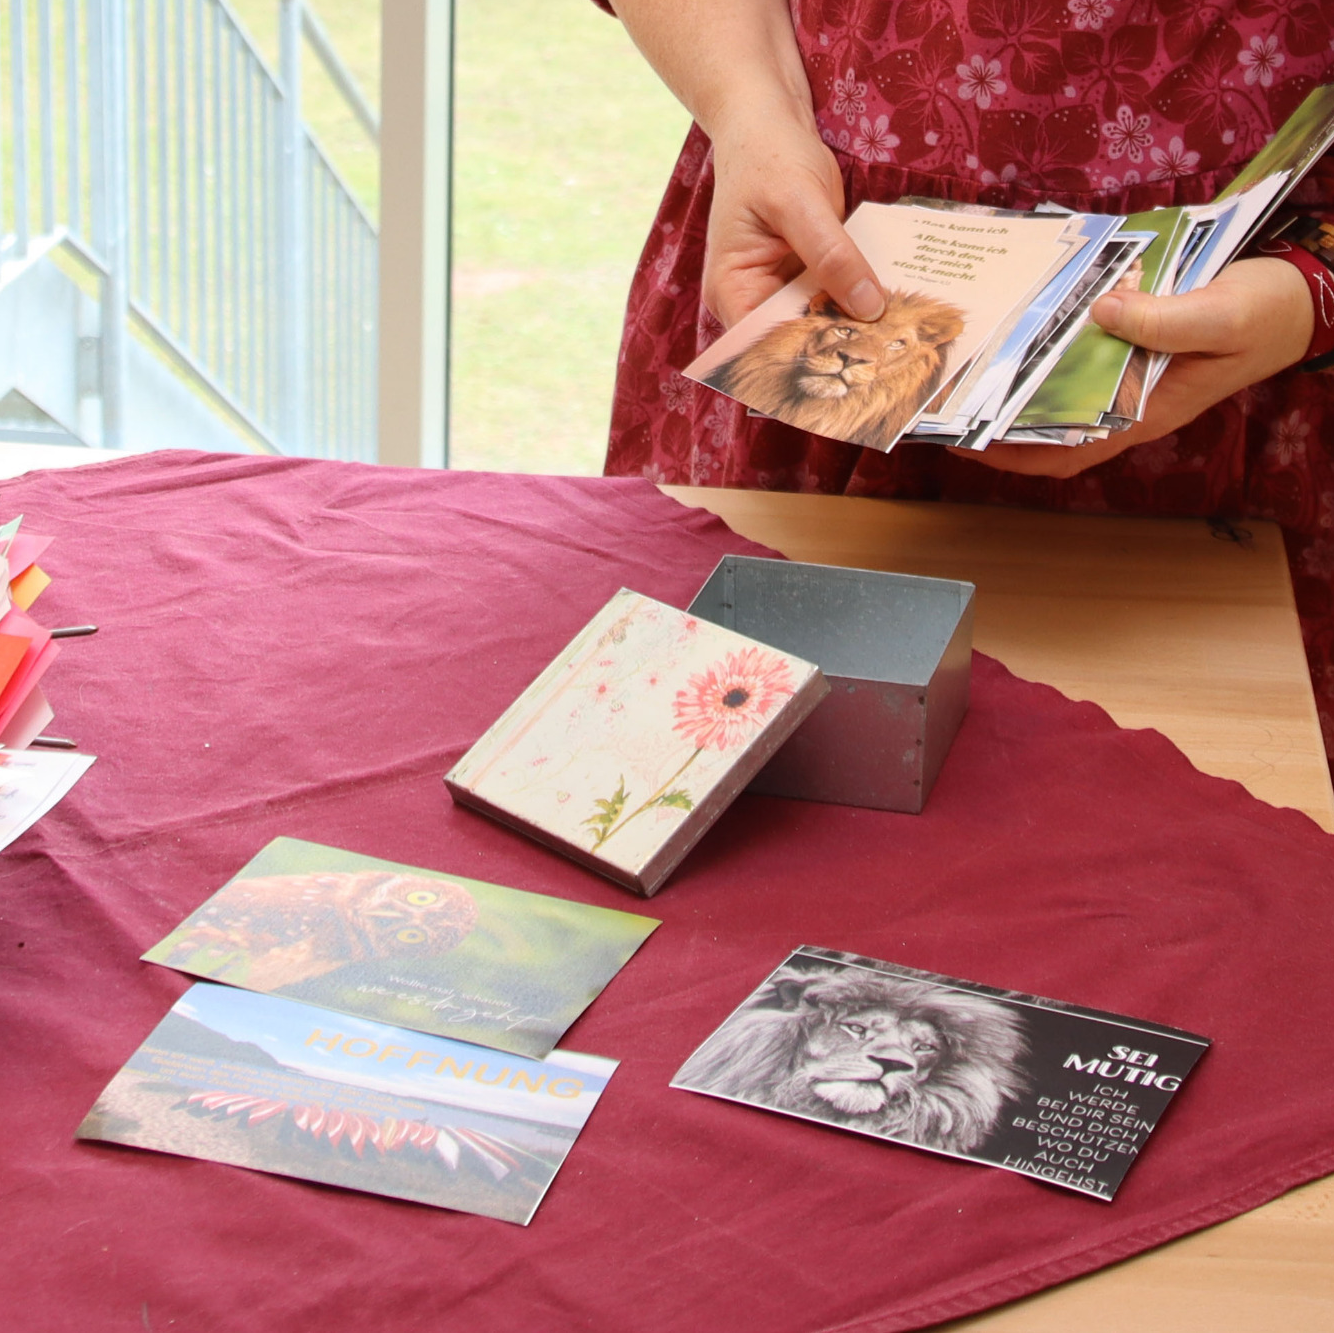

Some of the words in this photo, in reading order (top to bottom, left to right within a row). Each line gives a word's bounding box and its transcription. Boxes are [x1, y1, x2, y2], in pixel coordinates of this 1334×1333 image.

[987, 227, 1009, 235] ich
[913, 233, 948, 245] Alles
[950, 240, 985, 252] kann
[987, 246, 1008, 255] ich
[916, 244, 957, 257] durch
[892, 260, 931, 273] stark
[930, 268, 977, 282] macht.
[913, 254, 939, 263] der
[938, 260, 974, 270] mich
[389, 974, 428, 991] Wollte
[305, 1028, 585, 1100] HOFFNUNG
[1107, 1045, 1159, 1067] SEI
[1062, 1053, 1182, 1092] MUTIG
[1093, 1084, 1129, 1099] ICH
[1069, 1091, 1140, 1115] WERDE
[1037, 1097, 1068, 1111] BEI
[1071, 1106, 1105, 1120] DIR
[1109, 1114, 1155, 1133] SEIN
[1038, 1109, 1083, 1128] UND
[1088, 1123, 1139, 1142] DICH
[1037, 1136, 1073, 1152] WO
[1077, 1147, 1110, 1162] DU
[1034, 1151, 1095, 1173] AUCH
